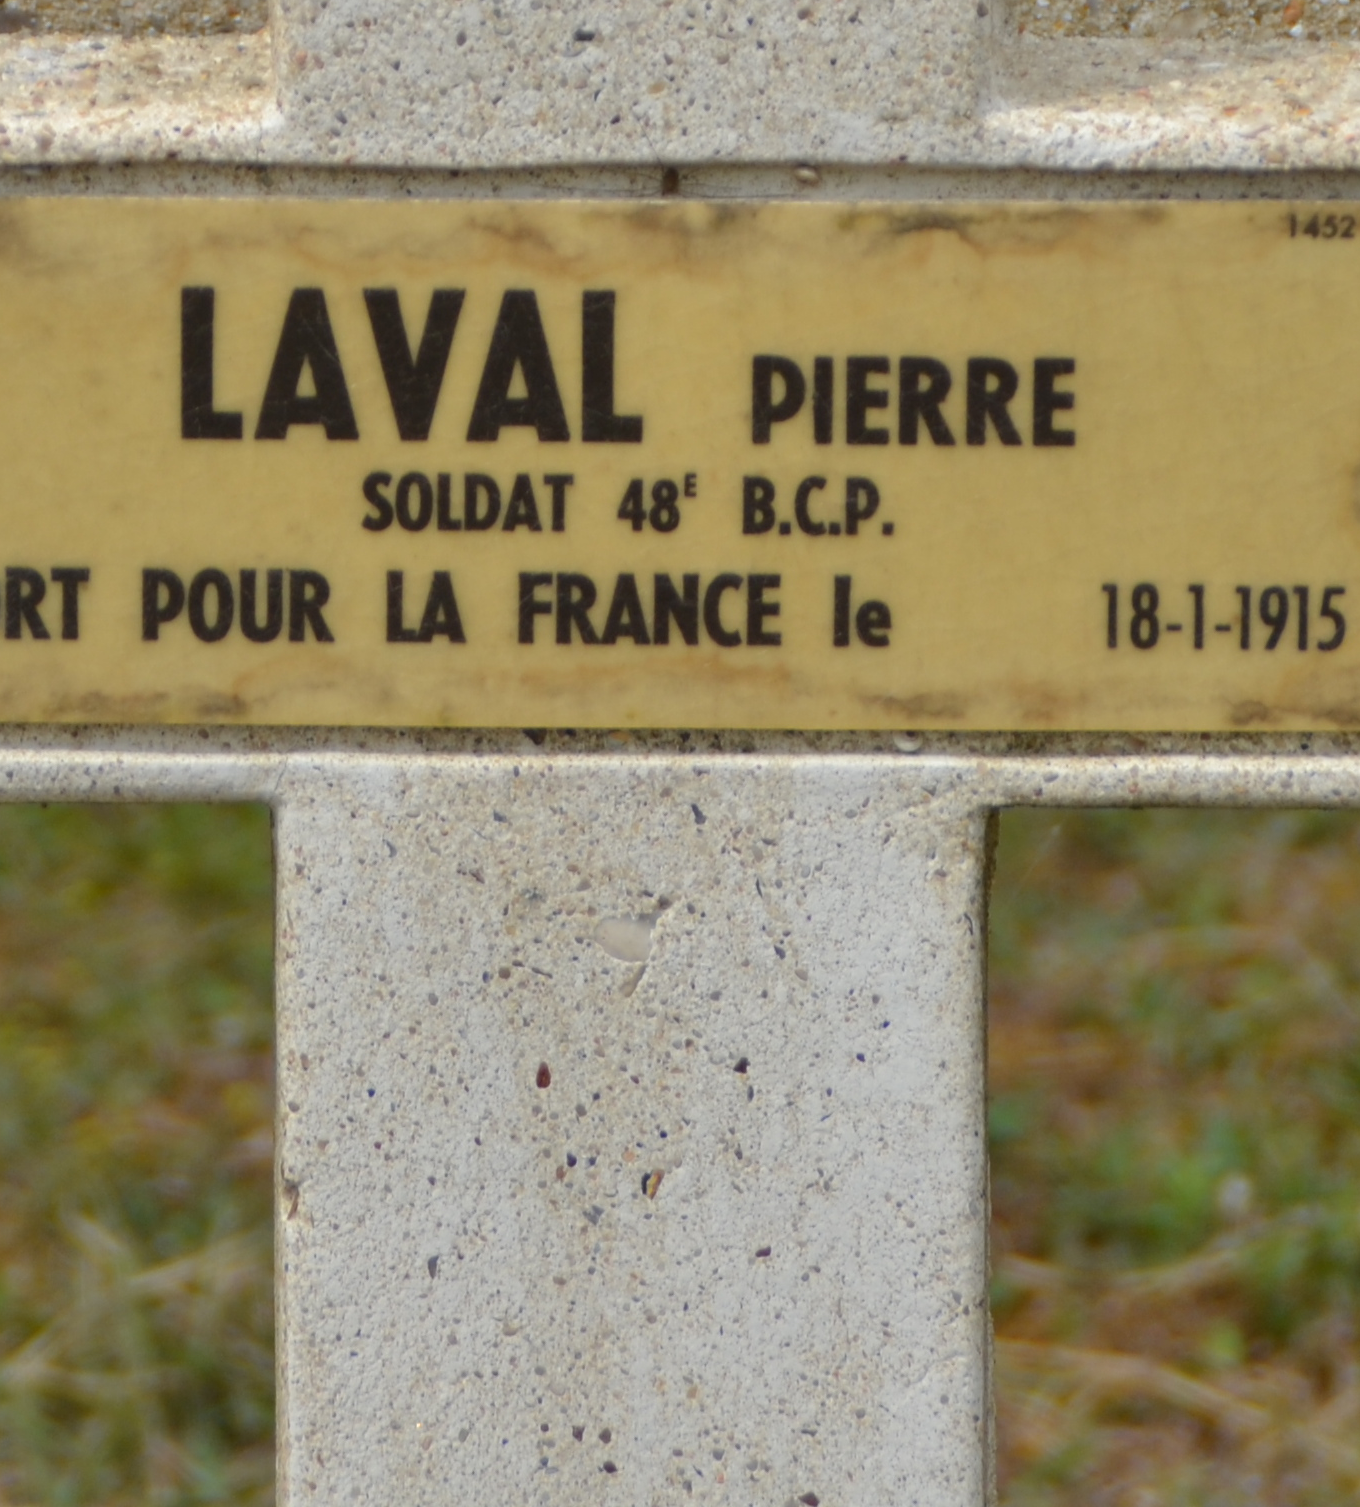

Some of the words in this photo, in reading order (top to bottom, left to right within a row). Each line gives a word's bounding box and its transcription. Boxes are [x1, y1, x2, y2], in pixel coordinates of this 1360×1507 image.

[1287, 213, 1358, 239] 1452
[180, 286, 643, 443] LAVAL
[751, 355, 1076, 448] PIERRE
[362, 471, 575, 533] SOLDAT
[742, 476, 895, 537] B.C.P.
[142, 567, 334, 644] POUR
[386, 570, 466, 644] LA
[518, 572, 782, 648] FRANCE
[833, 575, 892, 648] le
[1102, 583, 1346, 652] 18-1-1915
